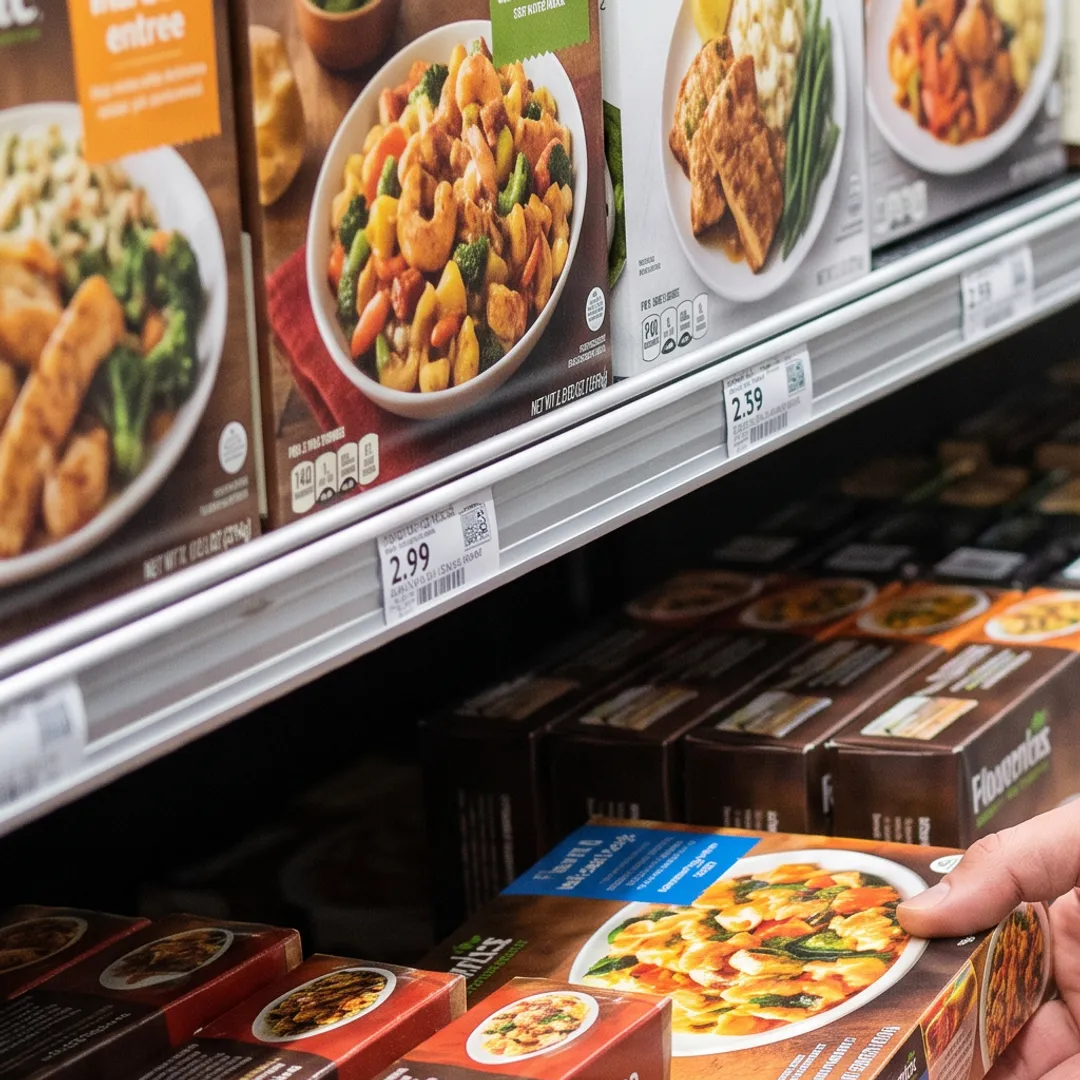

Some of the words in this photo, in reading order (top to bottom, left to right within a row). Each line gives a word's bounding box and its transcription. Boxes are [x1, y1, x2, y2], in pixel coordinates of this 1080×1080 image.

[105, 10, 187, 54] entree
[731, 386, 763, 422] 2.59
[390, 542, 430, 585] 2.99
